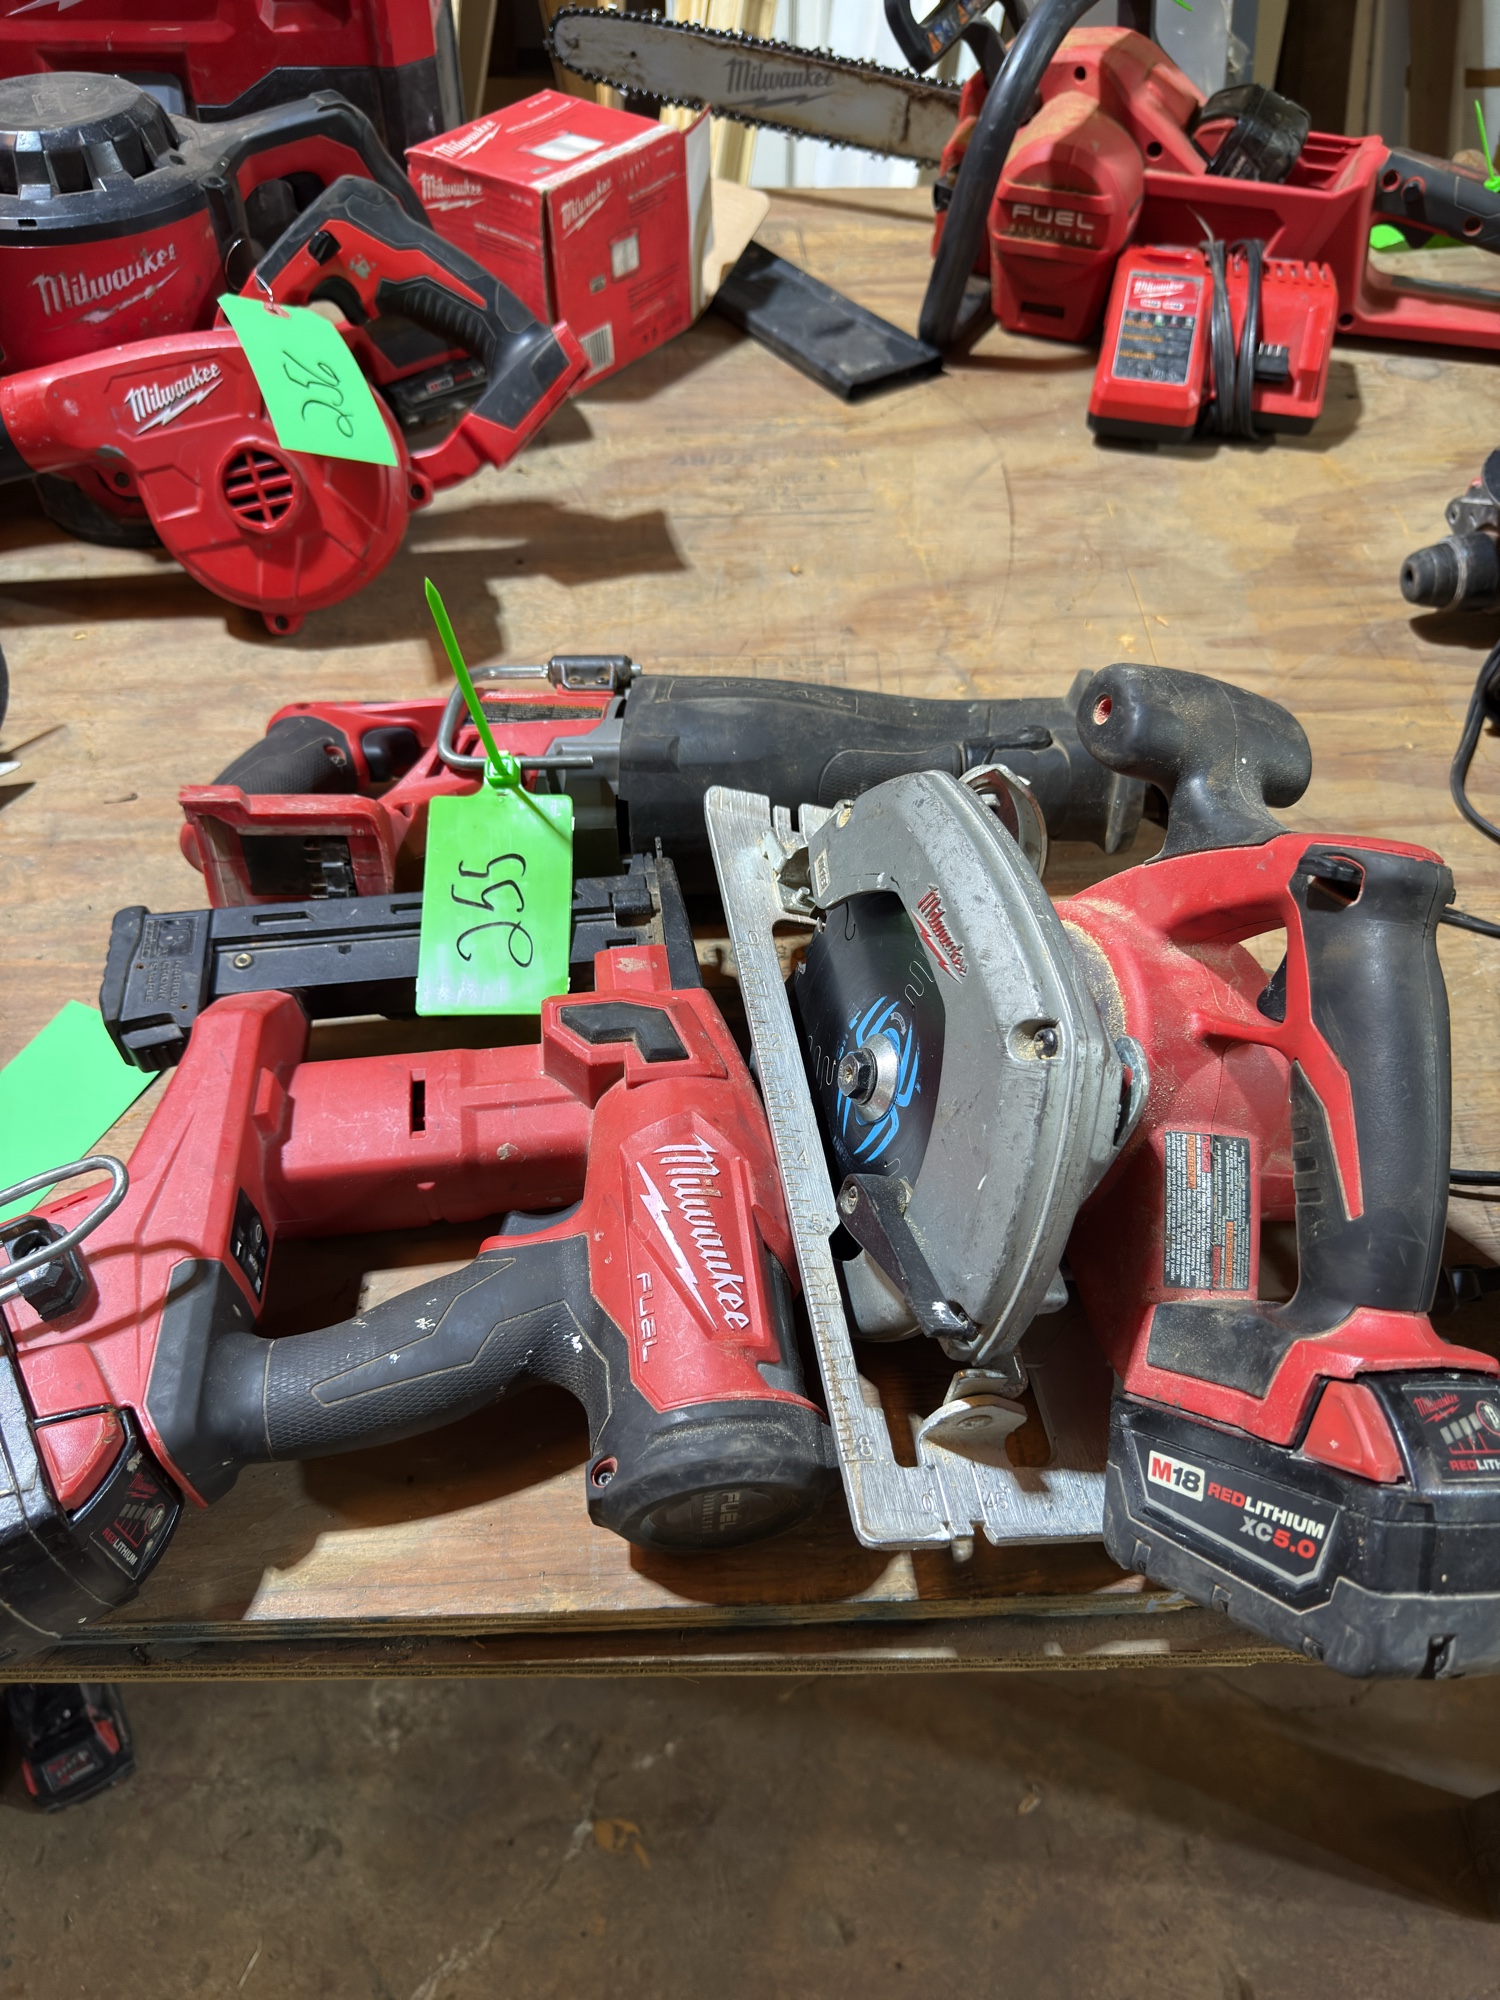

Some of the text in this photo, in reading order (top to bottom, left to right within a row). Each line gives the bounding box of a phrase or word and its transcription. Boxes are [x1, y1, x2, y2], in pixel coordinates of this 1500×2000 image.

[724, 56, 836, 94] Milwaukee
[431, 120, 497, 158] Milwaukee
[419, 173, 483, 200] Milwaukee
[559, 179, 614, 230] Milwaukee
[1011, 202, 1096, 232] FUEL
[31, 242, 176, 317] Milwaukee
[124, 362, 222, 424] Milwaukee
[281, 349, 355, 438] 256
[450, 852, 534, 968] 255
[916, 883, 969, 978] Milwaukee
[145, 961, 159, 1003] STAPLE
[158, 960, 171, 1001] CROWN
[170, 959, 184, 1006] NARROW
[652, 1132, 751, 1332] Milwaukee
[636, 1272, 658, 1364] FUEL
[856, 1435, 872, 1456] 8
[1151, 1456, 1202, 1494] M18
[719, 1490, 741, 1532] FUEL
[1207, 1481, 1325, 1540] REDLITHIUM
[101, 1527, 139, 1566] REDLITHIUM
[1239, 1515, 1316, 1559] XC5.0
